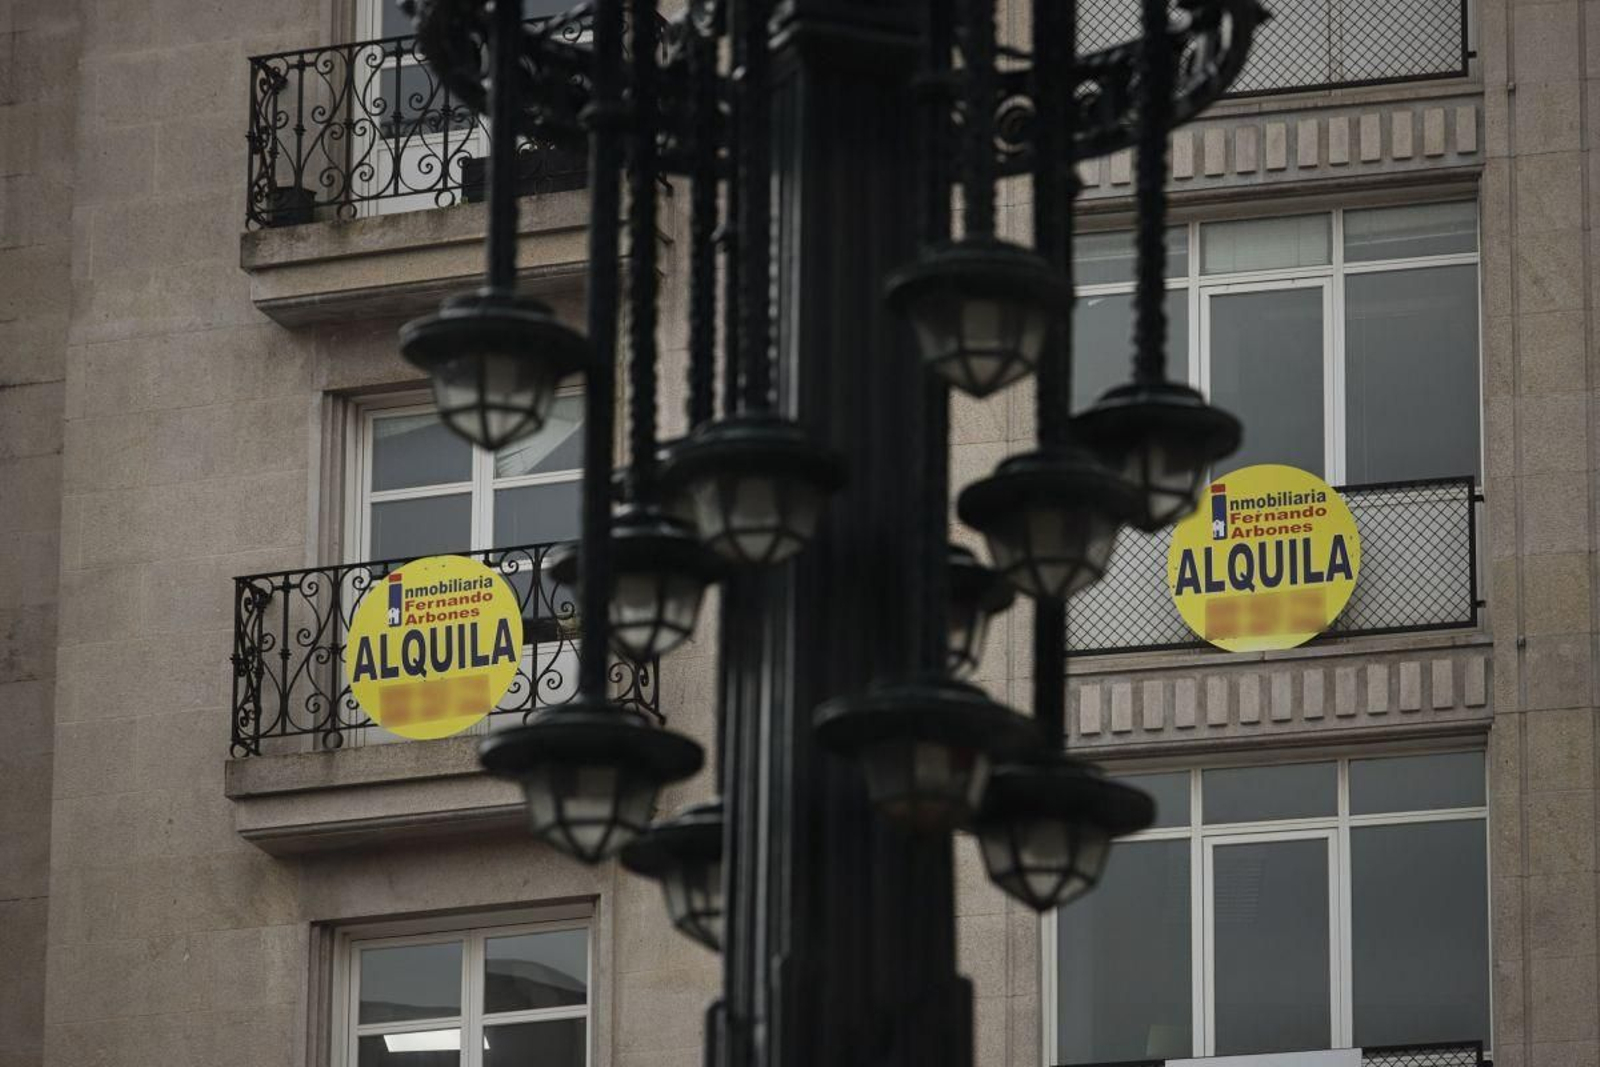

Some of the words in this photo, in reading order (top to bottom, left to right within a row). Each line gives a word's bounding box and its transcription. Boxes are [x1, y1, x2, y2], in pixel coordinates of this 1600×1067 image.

[1230, 506, 1327, 525] Fernando
[1231, 522, 1313, 539] Arbones
[1175, 534, 1353, 596] ALQUILA
[404, 591, 493, 612] Fernando
[405, 607, 480, 626] Arbones
[353, 618, 516, 683] ALQUILA
